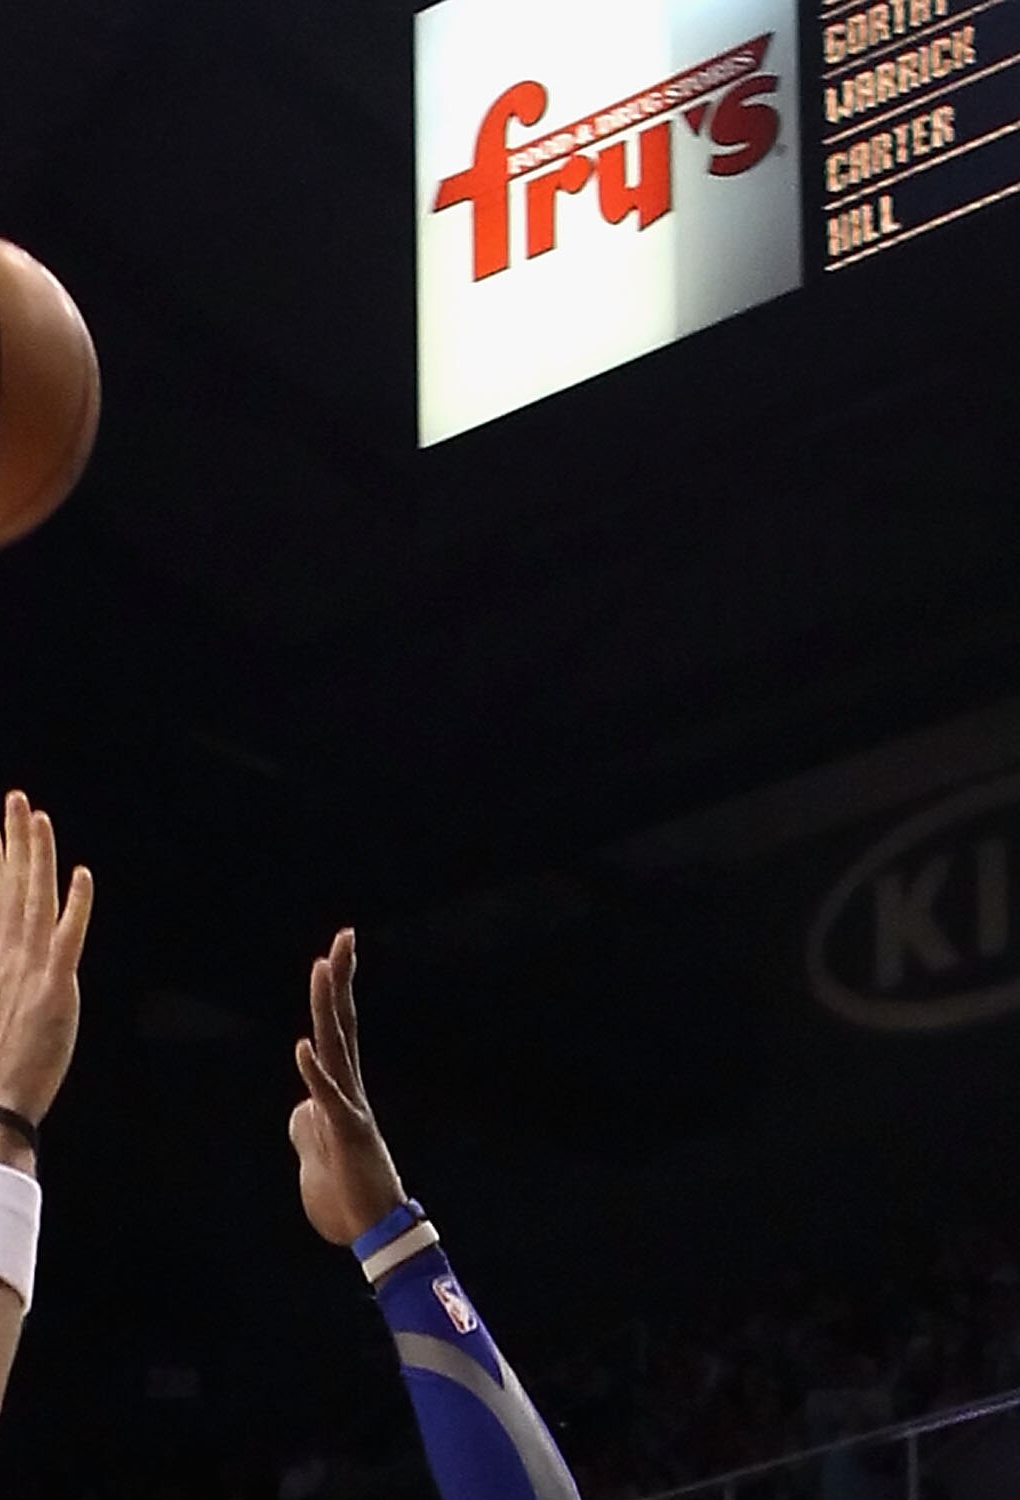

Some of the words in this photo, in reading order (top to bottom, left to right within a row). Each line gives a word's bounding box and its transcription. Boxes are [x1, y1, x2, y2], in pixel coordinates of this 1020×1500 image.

[824, 25, 977, 123] WARRICK
[433, 74, 780, 282] fry's
[825, 104, 956, 192] CARTER
[827, 195, 901, 256] HILL
